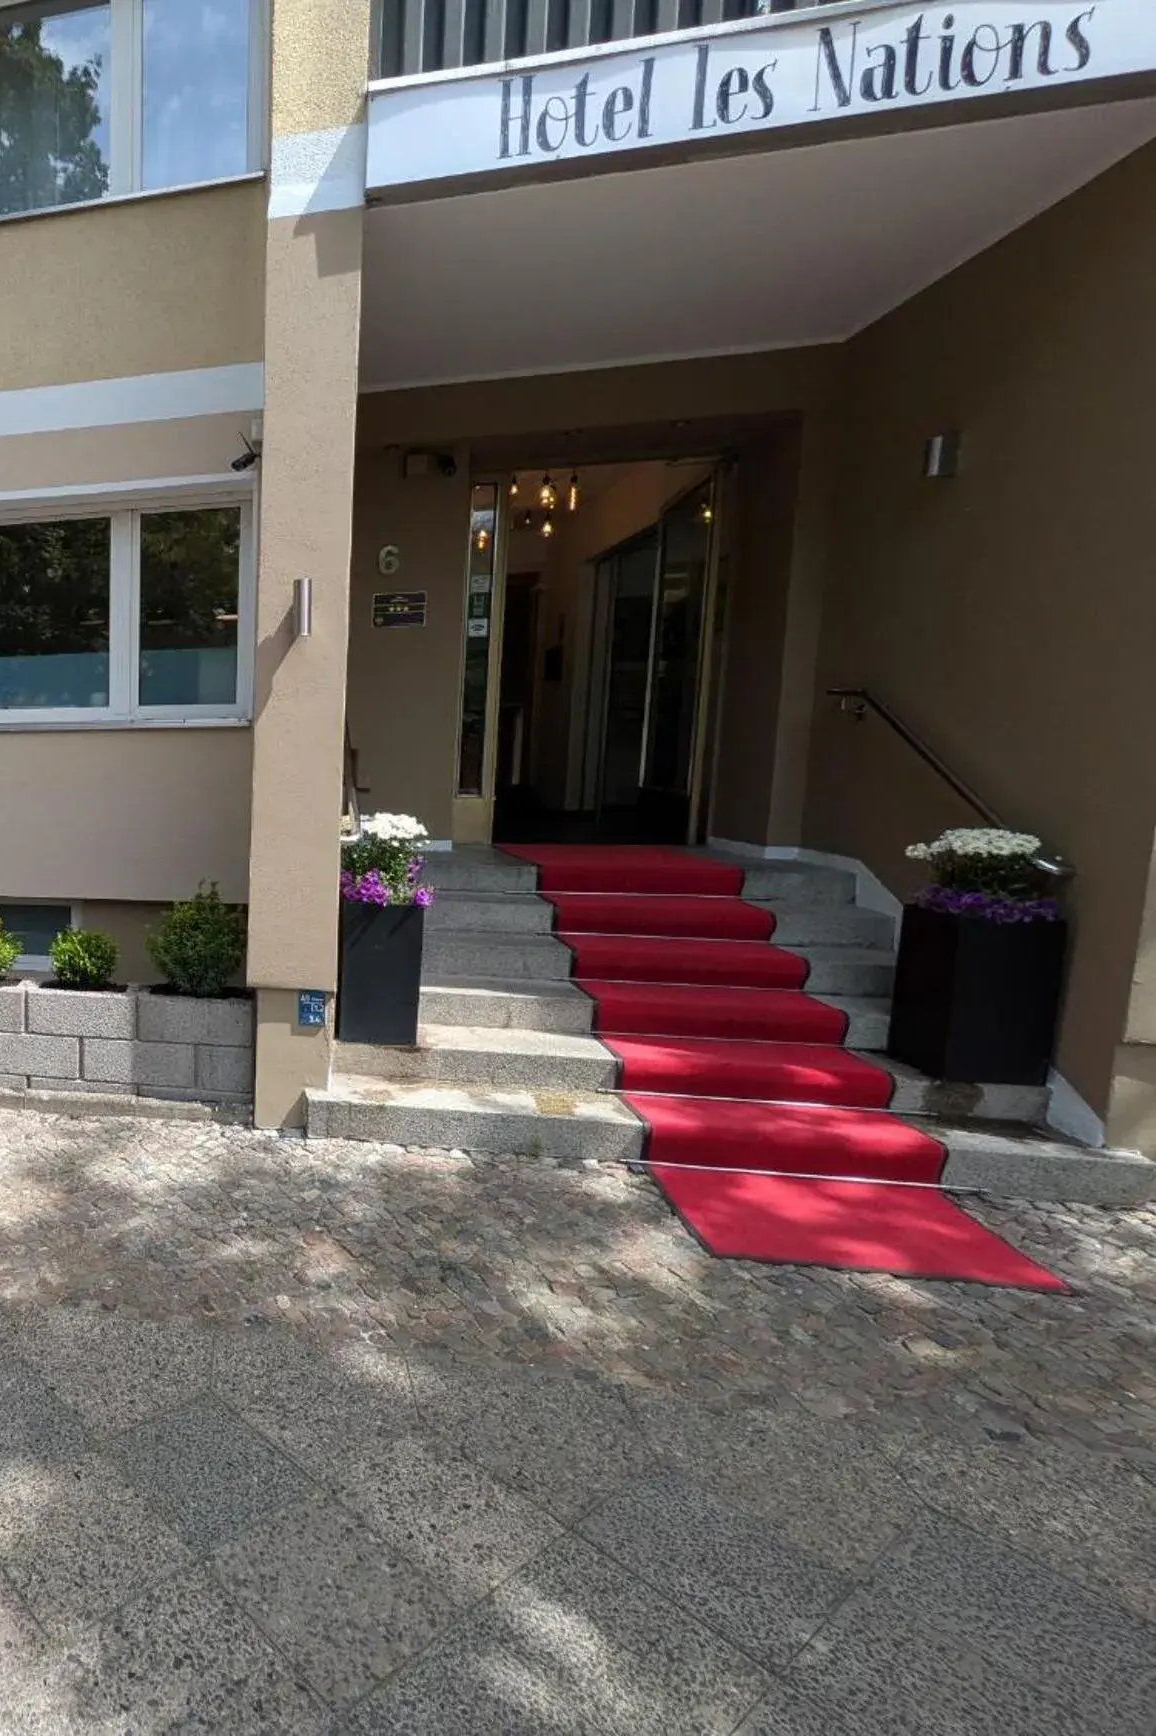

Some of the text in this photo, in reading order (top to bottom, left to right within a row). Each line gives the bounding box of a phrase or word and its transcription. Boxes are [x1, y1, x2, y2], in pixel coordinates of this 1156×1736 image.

[497, 56, 656, 159] Hotel
[806, 4, 1096, 113] Nations
[379, 544, 400, 574] 6
